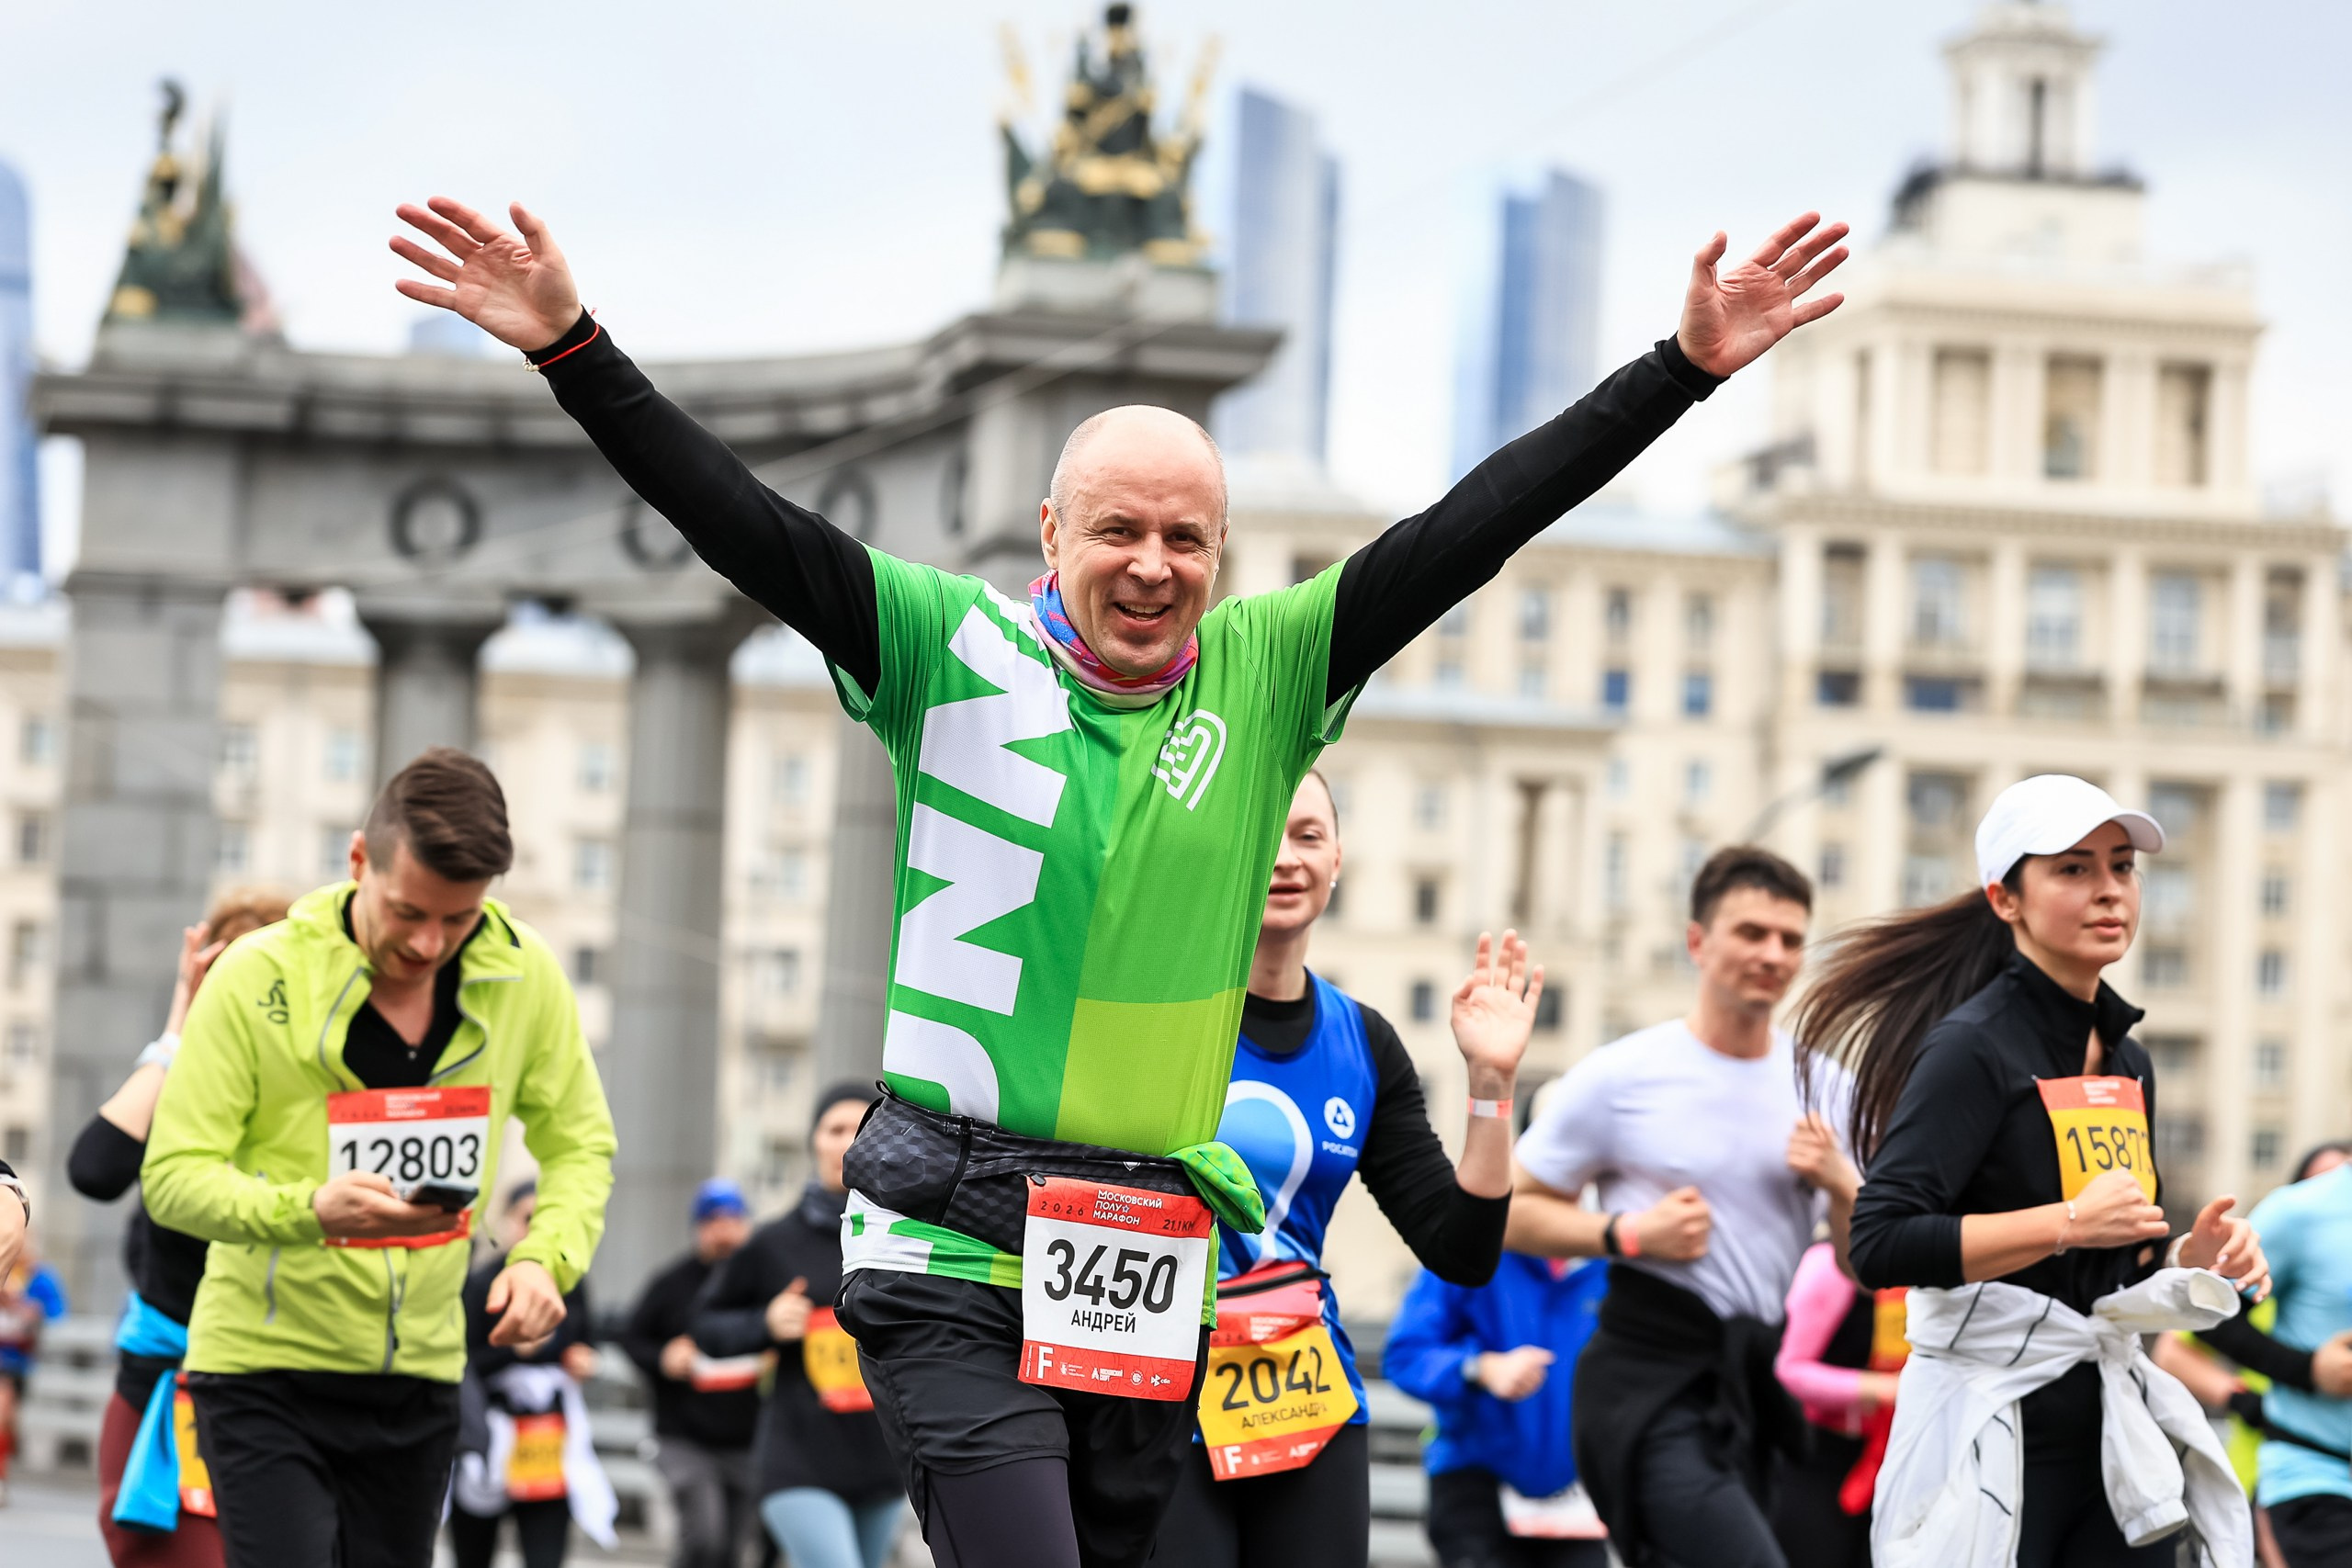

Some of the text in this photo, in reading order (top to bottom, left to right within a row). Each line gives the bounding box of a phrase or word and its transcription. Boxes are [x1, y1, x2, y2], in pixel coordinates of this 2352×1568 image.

[340, 1134, 480, 1182] 12803
[1041, 1201, 1084, 1216] 2026
[1095, 1201, 1122, 1213] ПОЛУ
[1097, 1190, 1163, 1209] МОСКОВСКИЙ
[1092, 1211, 1140, 1225] МАРАФОН
[1044, 1239, 1178, 1314] 3450
[1071, 1310, 1136, 1333] АНДРЕЙ
[1037, 1346, 1054, 1379] F
[1216, 1346, 1331, 1411] 2042
[1223, 1446, 1243, 1474] F
